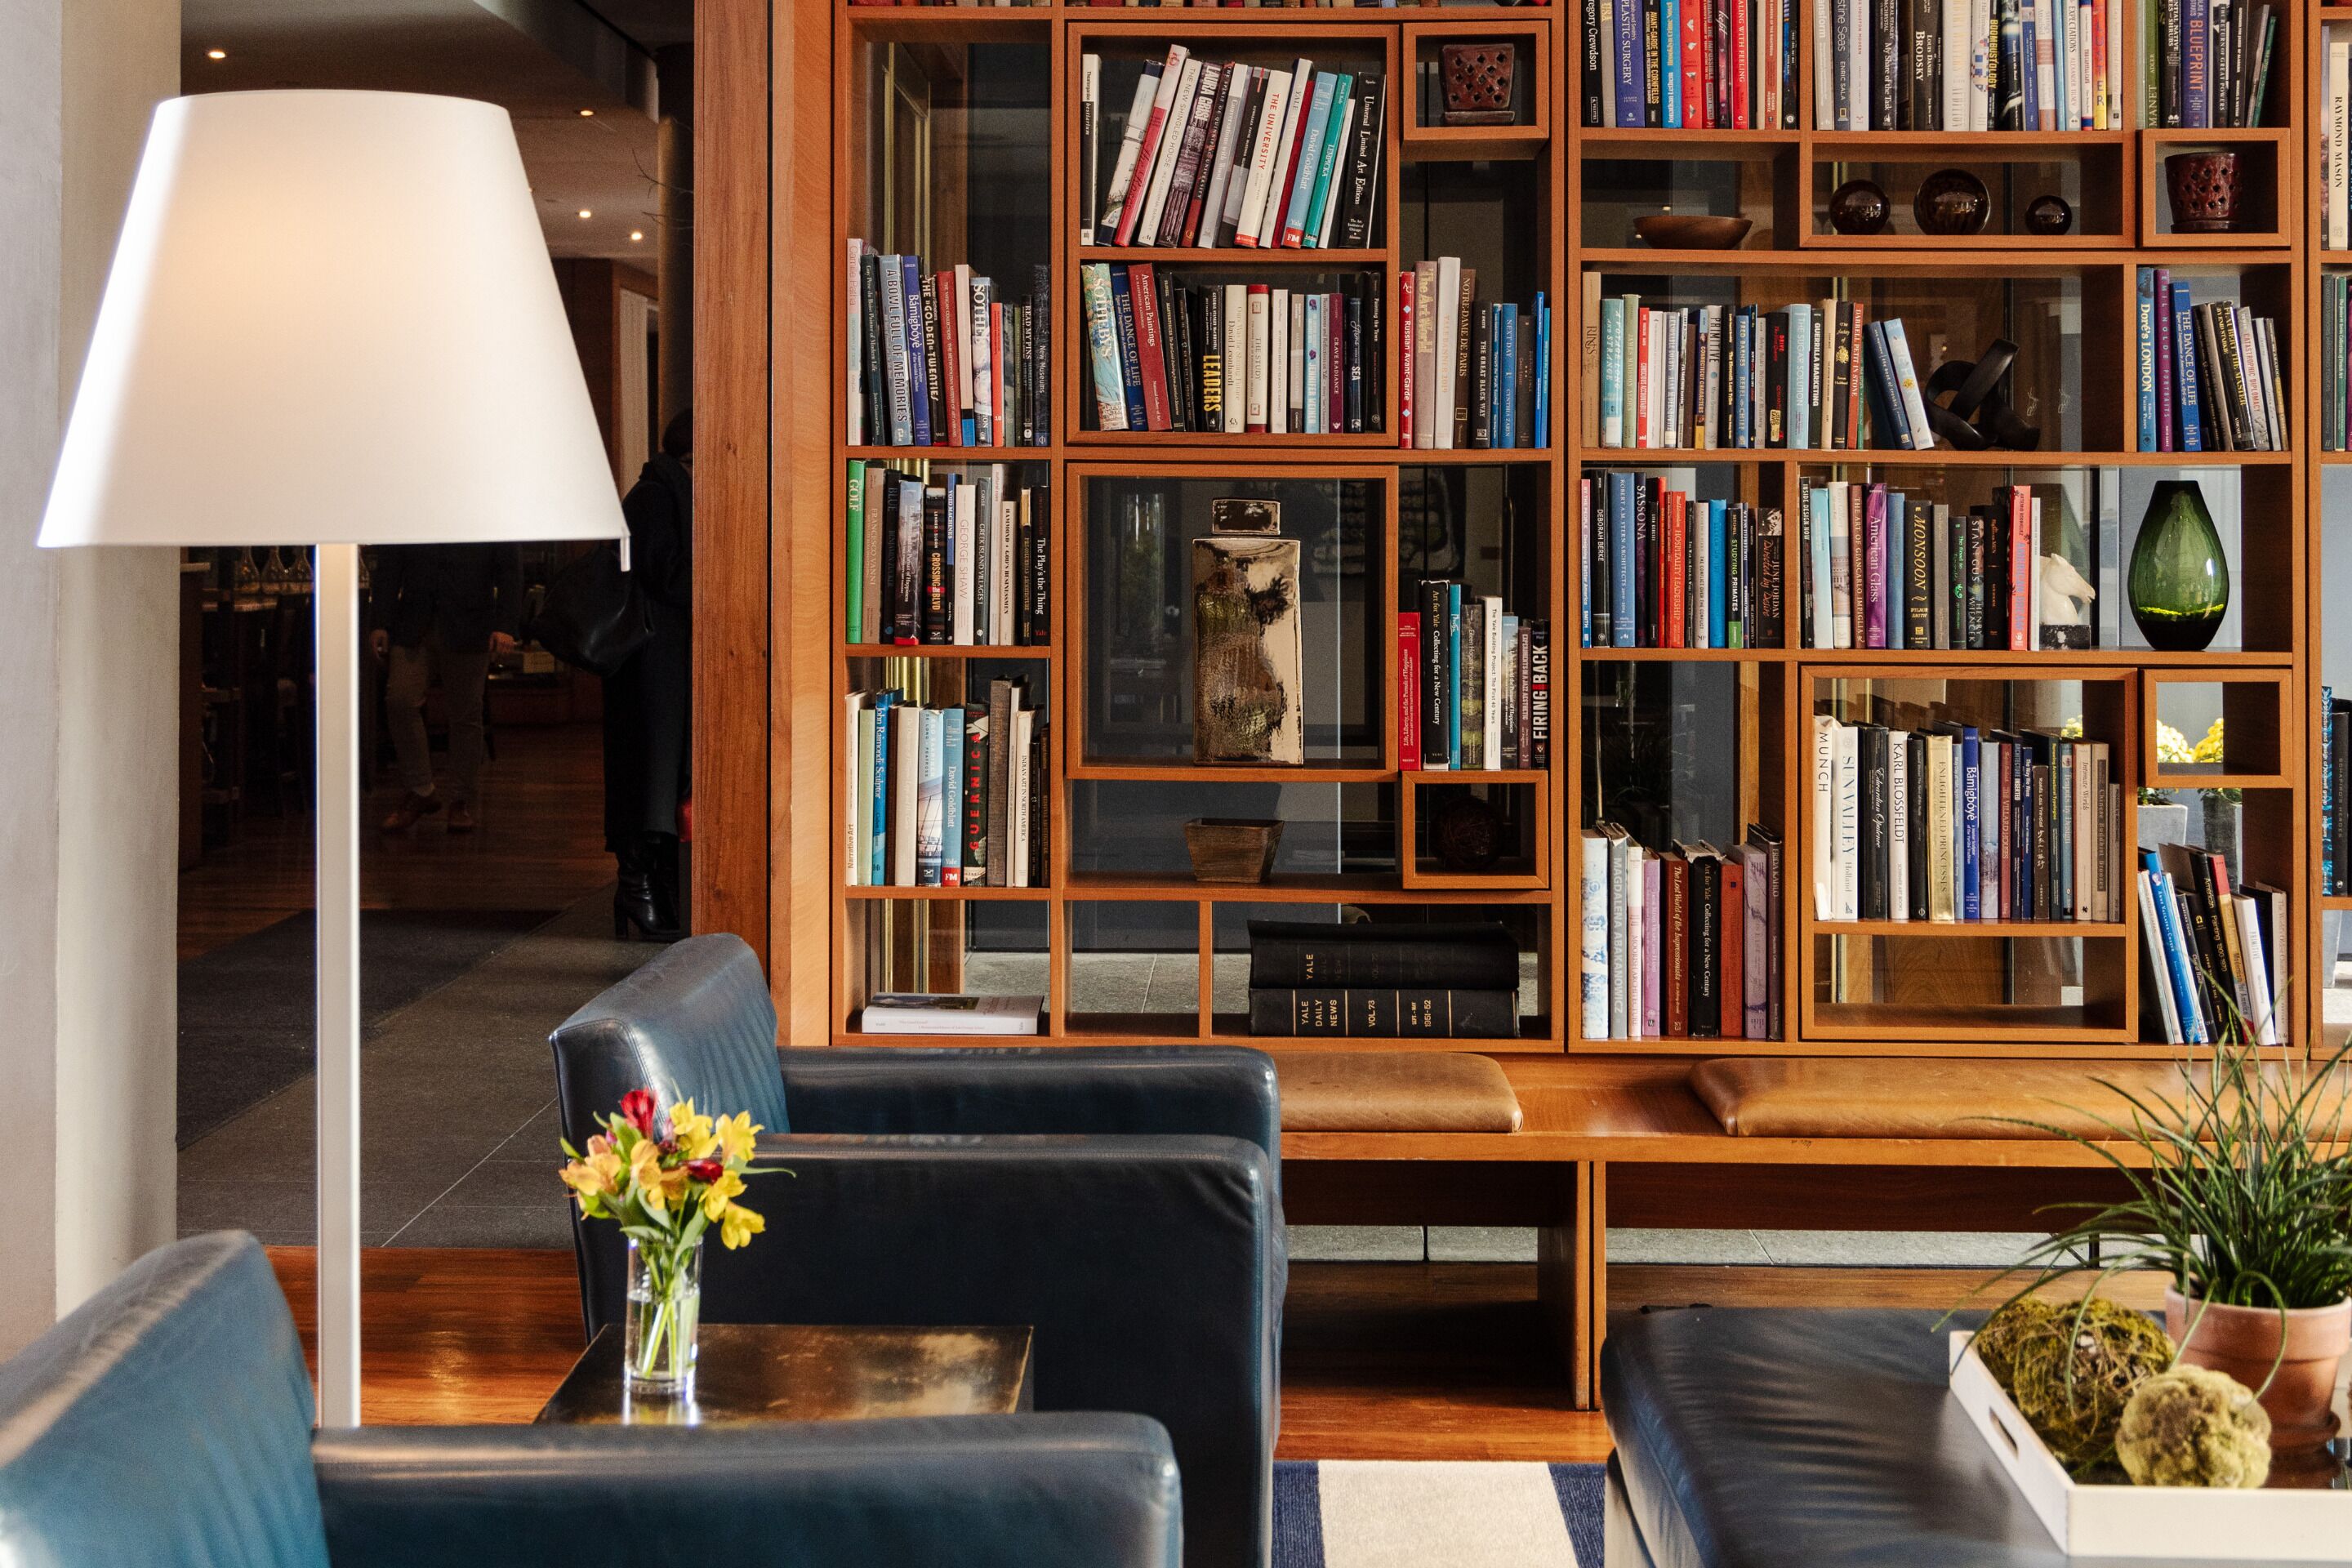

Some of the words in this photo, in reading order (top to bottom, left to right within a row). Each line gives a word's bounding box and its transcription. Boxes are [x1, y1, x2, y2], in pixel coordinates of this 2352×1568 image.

[1586, 0, 1596, 26] regory
[1621, 0, 1630, 38] PLASTIC
[1589, 28, 1599, 70] Crewdson
[1622, 40, 1631, 85] SURGERY
[1883, 43, 1891, 53] My
[1988, 20, 1998, 88] BOOMBUSTOLOGY
[2189, 20, 2203, 91] BLUEPRINT
[1186, 69, 1196, 82] THE
[1202, 65, 1220, 94] LAURA
[1182, 84, 1192, 101] NEW
[1270, 94, 1279, 109] THE
[1171, 105, 1188, 140] SHINGLED
[1194, 96, 1213, 121] GRISI
[1362, 96, 1374, 126] Universal
[2335, 96, 2343, 146] RAYMOND
[1164, 142, 1178, 167] HOUSE
[1258, 114, 1276, 170] UNIVERSITY
[1307, 129, 1319, 151] David
[1360, 131, 1370, 157] Limited
[1300, 154, 1314, 189] Goldblatt
[1357, 160, 1367, 173] Art
[1354, 177, 1365, 204] Editions
[887, 281, 898, 312] BOWL
[1121, 292, 1130, 313] THE
[1142, 274, 1152, 310] American
[1461, 278, 1470, 336] NOTRE-DAME
[889, 316, 901, 341] FULL
[1025, 328, 1031, 340] MY
[1124, 315, 1134, 347] DANCE
[1145, 313, 1156, 346] Paintings
[2182, 310, 2191, 330] THE
[892, 345, 902, 357] OF
[922, 280, 930, 297] THE
[929, 352, 938, 401] TWENTIES
[1460, 338, 1468, 350] DE
[1710, 318, 1721, 363] PRIMITIVE
[2183, 333, 2193, 367] DANCE
[1129, 351, 1137, 364] OF
[1459, 353, 1468, 376] PARIS
[2142, 342, 2151, 392] LONDON
[1132, 367, 1140, 386] LIFE
[1203, 355, 1221, 412] LEADERS
[1352, 367, 1360, 381] SEA
[2186, 371, 2194, 383] OF
[893, 361, 907, 421] MEMORIES
[2187, 385, 2195, 405] LIFE
[849, 479, 858, 511] GOLF
[1637, 485, 1646, 540] SASSONA
[960, 519, 969, 563] GEORGE
[1037, 538, 1045, 553] The
[1870, 516, 1881, 569] American
[1913, 515, 1926, 590] MONSOON
[932, 553, 940, 586] CROSSING
[1035, 555, 1045, 577] Play's
[960, 567, 968, 599] SHAW
[1036, 579, 1045, 589] the
[1870, 572, 1881, 602] Glass
[932, 594, 940, 610] BLVD
[1036, 591, 1045, 615] Thing
[1533, 645, 1548, 683] BACK
[875, 706, 884, 724] John
[1533, 691, 1548, 739] FIRING
[1819, 733, 1829, 791] MUNCH
[1842, 756, 1855, 788] SUN
[1894, 743, 1903, 773] KARL
[874, 767, 884, 798] Sculptor
[969, 733, 981, 849] GUERNICA
[1842, 795, 1855, 856] VALLEY
[1895, 777, 1904, 843] BLOSSFELDT
[1614, 858, 1622, 928] MAGDALENA
[1615, 932, 1623, 1013] ABAKANOWICZ
[1703, 971, 1711, 997] Century
